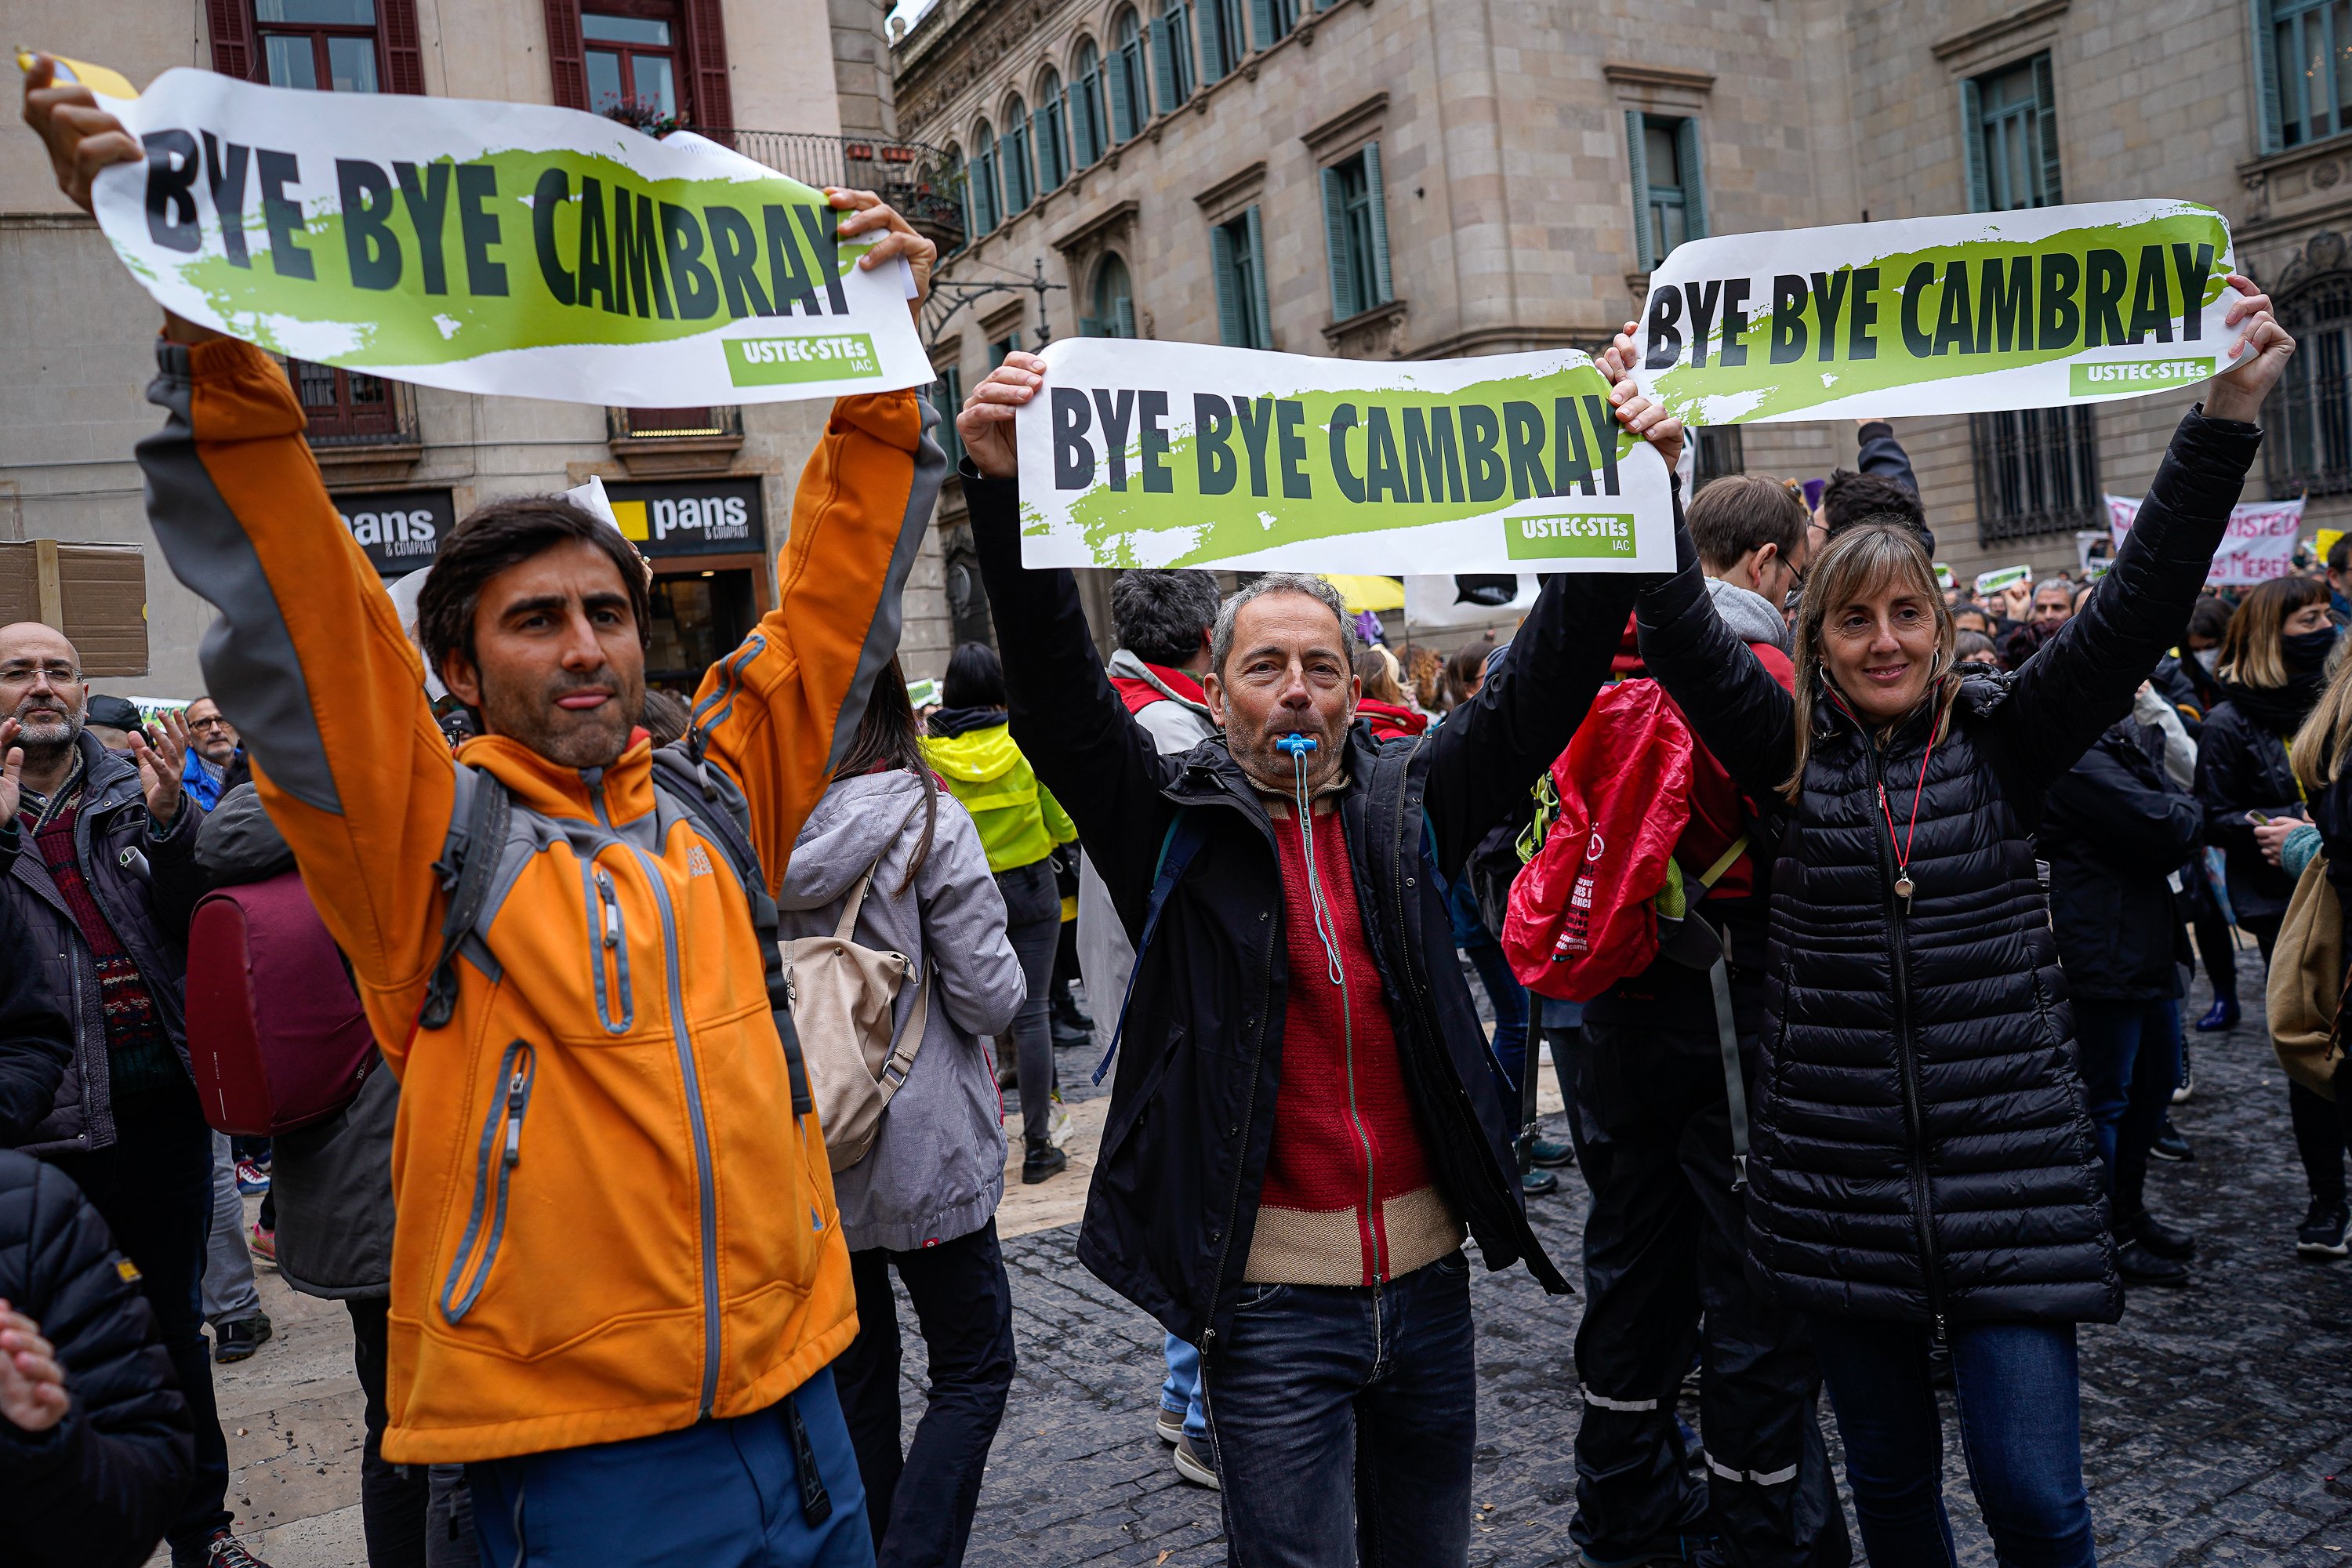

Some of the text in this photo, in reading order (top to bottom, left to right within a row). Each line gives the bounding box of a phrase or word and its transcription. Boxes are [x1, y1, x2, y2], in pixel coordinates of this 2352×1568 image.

[141, 129, 850, 320] BYE BYE CAMBRAY
[1645, 242, 2215, 370] BYE BYE CAMBRAY
[850, 358, 873, 373] IAC
[1051, 387, 1621, 503] BYE BYE CAMBRAY
[652, 496, 748, 541] pans
[704, 524, 749, 540] & COMPANY
[385, 539, 437, 557] & COMPANY
[1612, 539, 1630, 551] IAC
